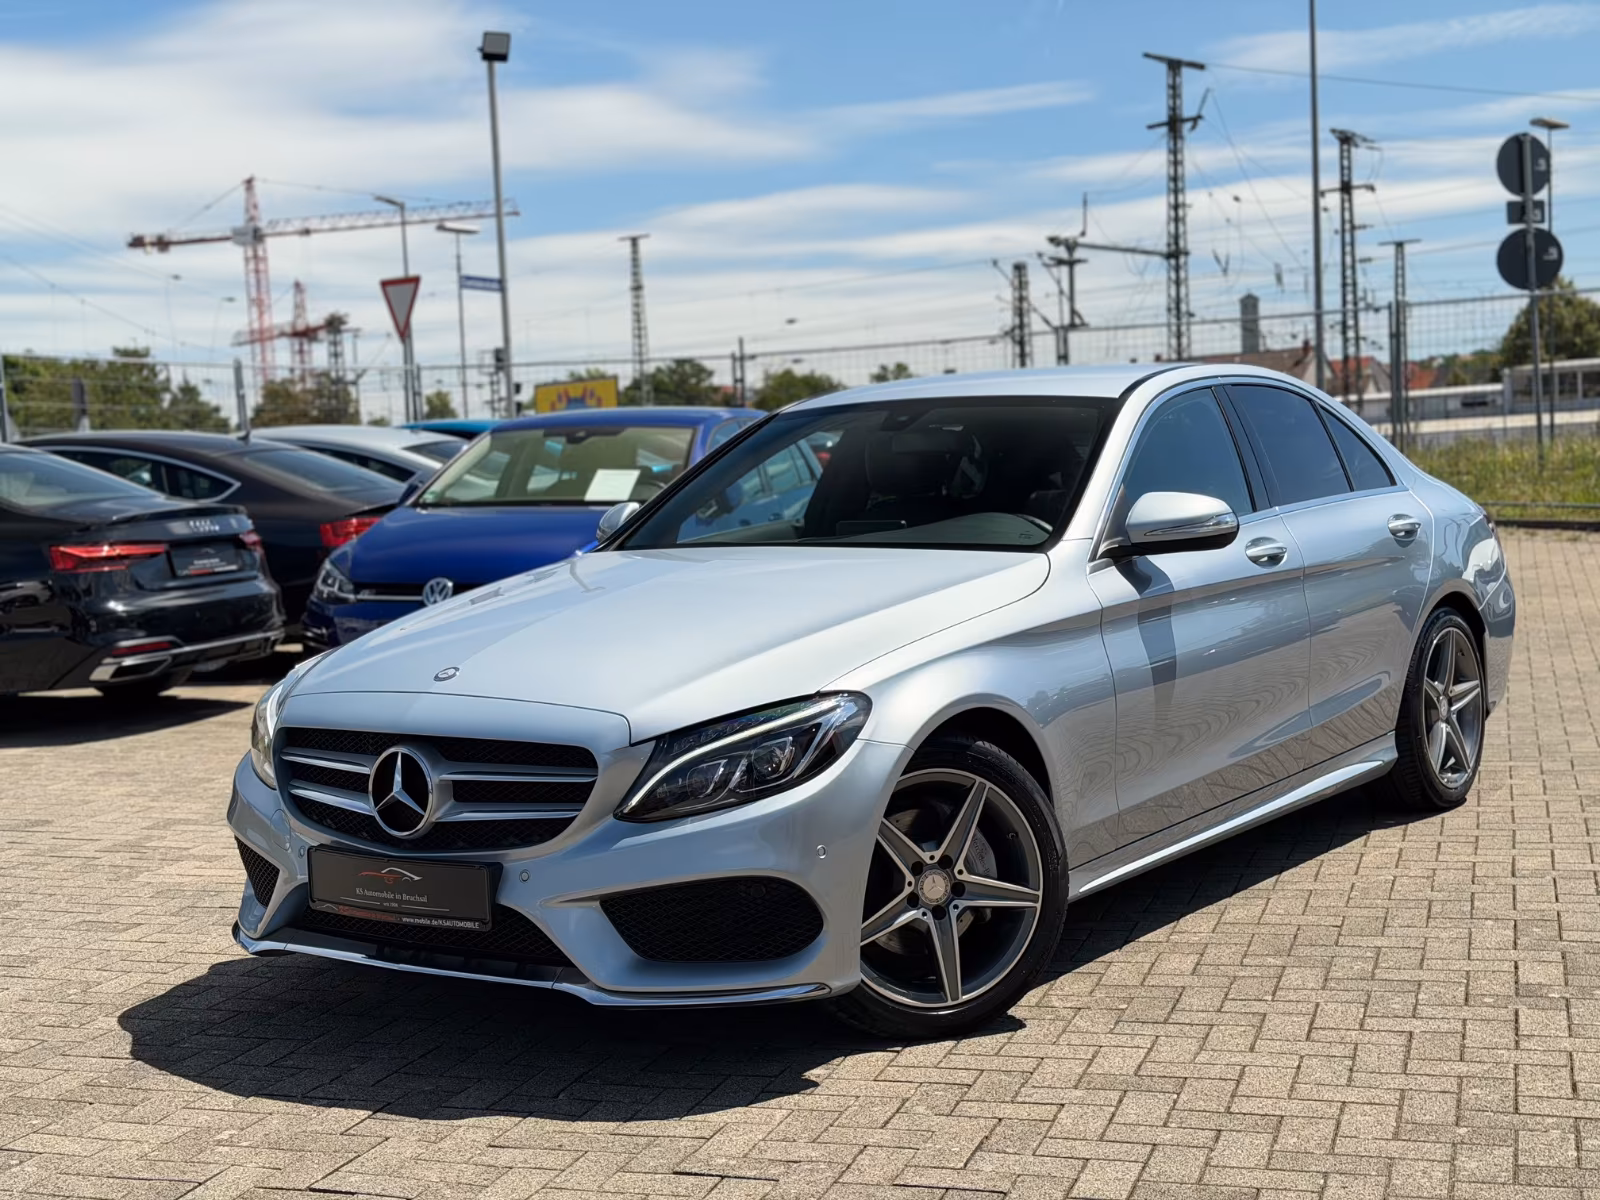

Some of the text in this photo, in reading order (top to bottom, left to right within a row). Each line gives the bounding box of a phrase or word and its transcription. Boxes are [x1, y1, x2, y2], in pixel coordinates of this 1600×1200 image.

[363, 889, 395, 899] Automobile
[395, 892, 402, 900] in
[402, 894, 428, 902] Bruchsal
